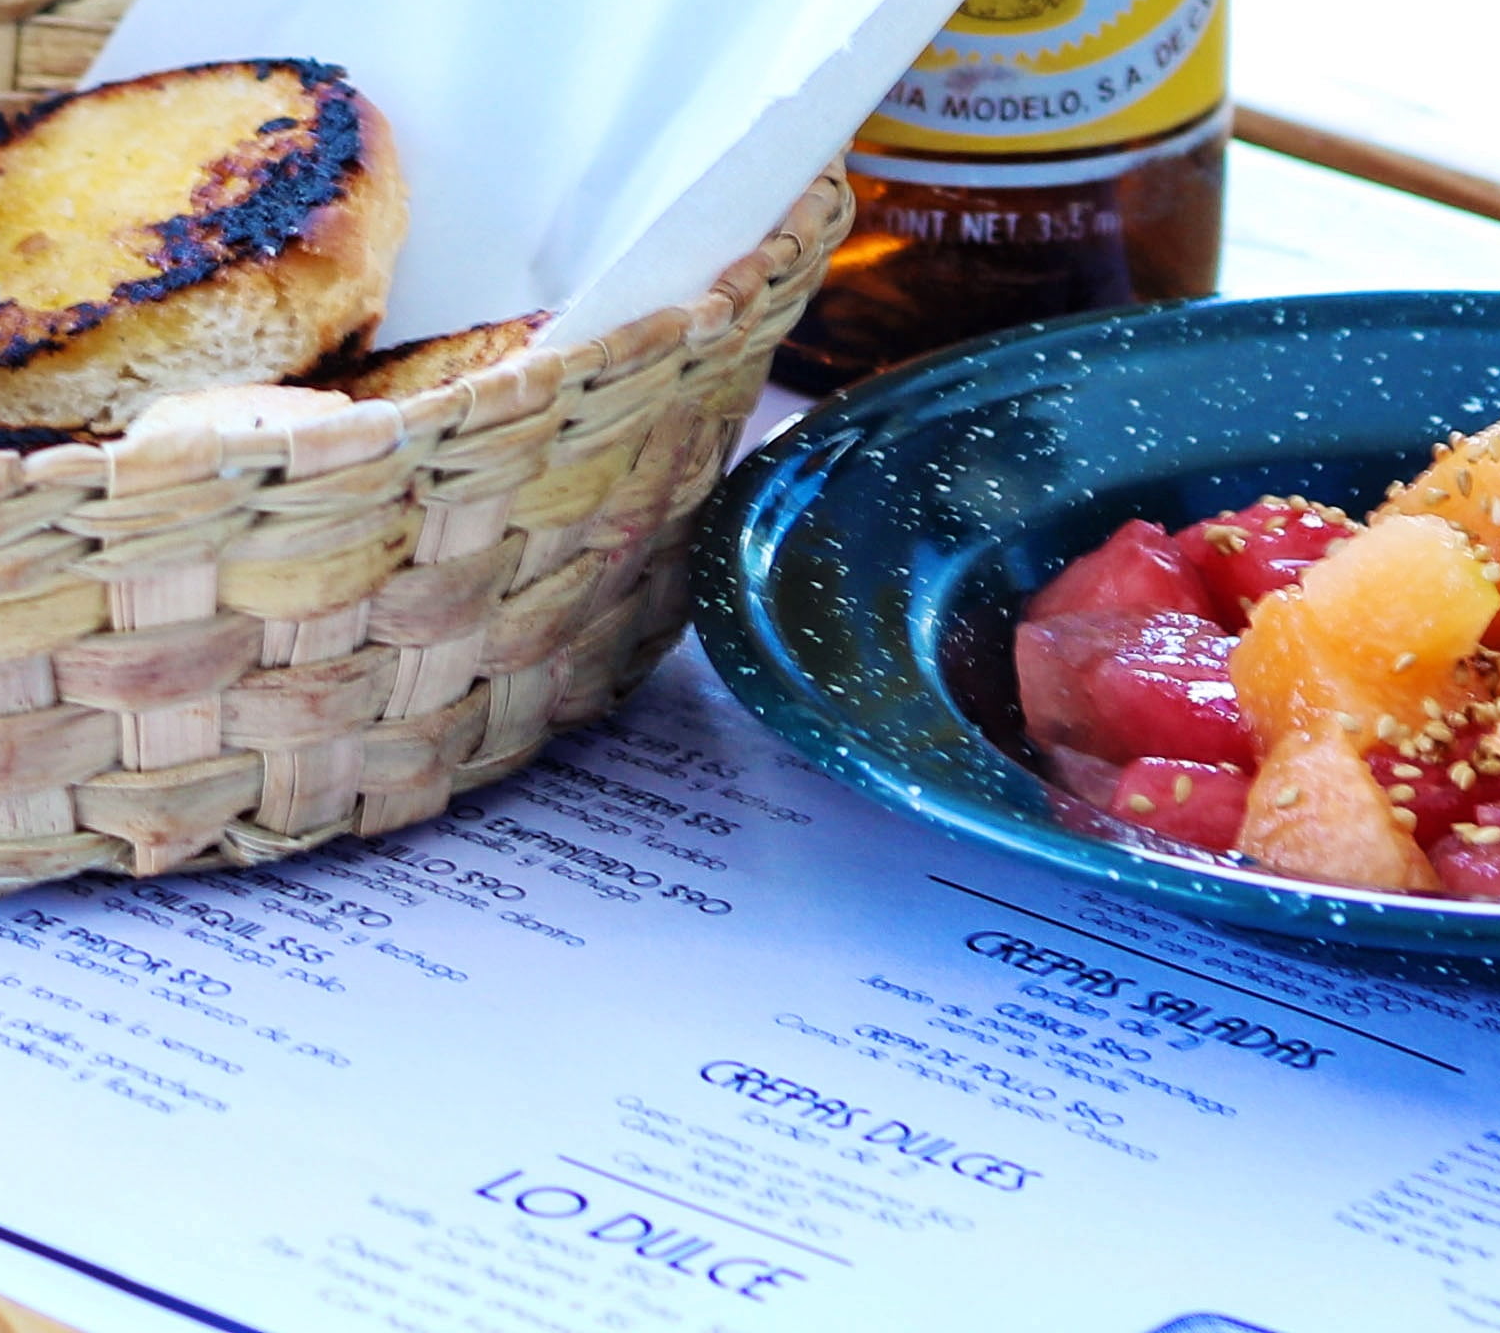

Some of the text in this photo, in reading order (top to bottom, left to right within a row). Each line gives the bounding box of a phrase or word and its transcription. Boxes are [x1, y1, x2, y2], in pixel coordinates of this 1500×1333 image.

[1152, 30, 1187, 70] DE
[962, 929, 1337, 1071] CREPAS SALADAS
[698, 1059, 1041, 1191] CREPAS DULCES
[473, 1169, 589, 1216] LO
[585, 1211, 806, 1302] DULCE
